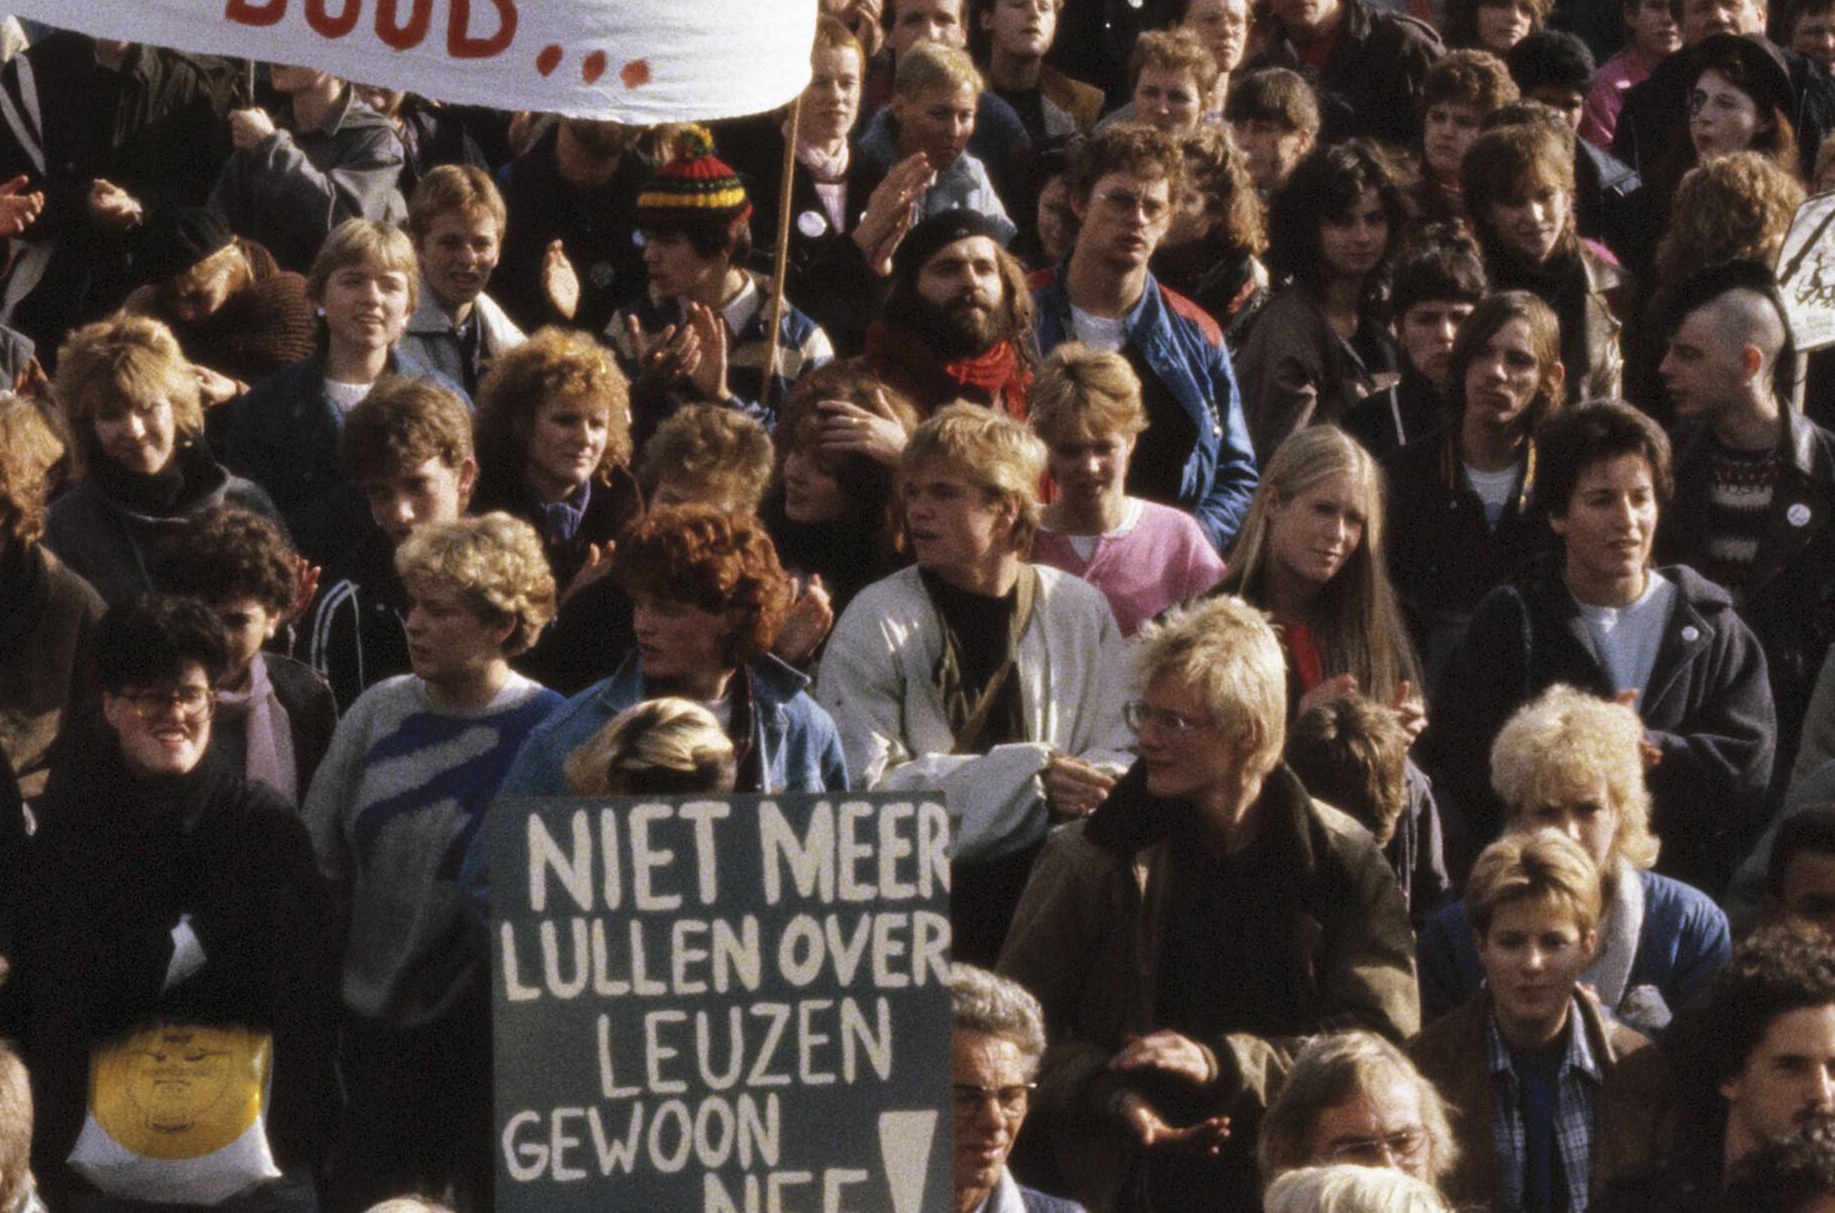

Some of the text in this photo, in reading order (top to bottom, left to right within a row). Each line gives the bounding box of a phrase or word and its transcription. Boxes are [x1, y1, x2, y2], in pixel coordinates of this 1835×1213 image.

[526, 800, 952, 913] NIET MEER
[501, 910, 953, 1002] LULLEN OVER
[597, 996, 894, 1100] LEUZEN
[501, 1091, 781, 1182] GEWOON
